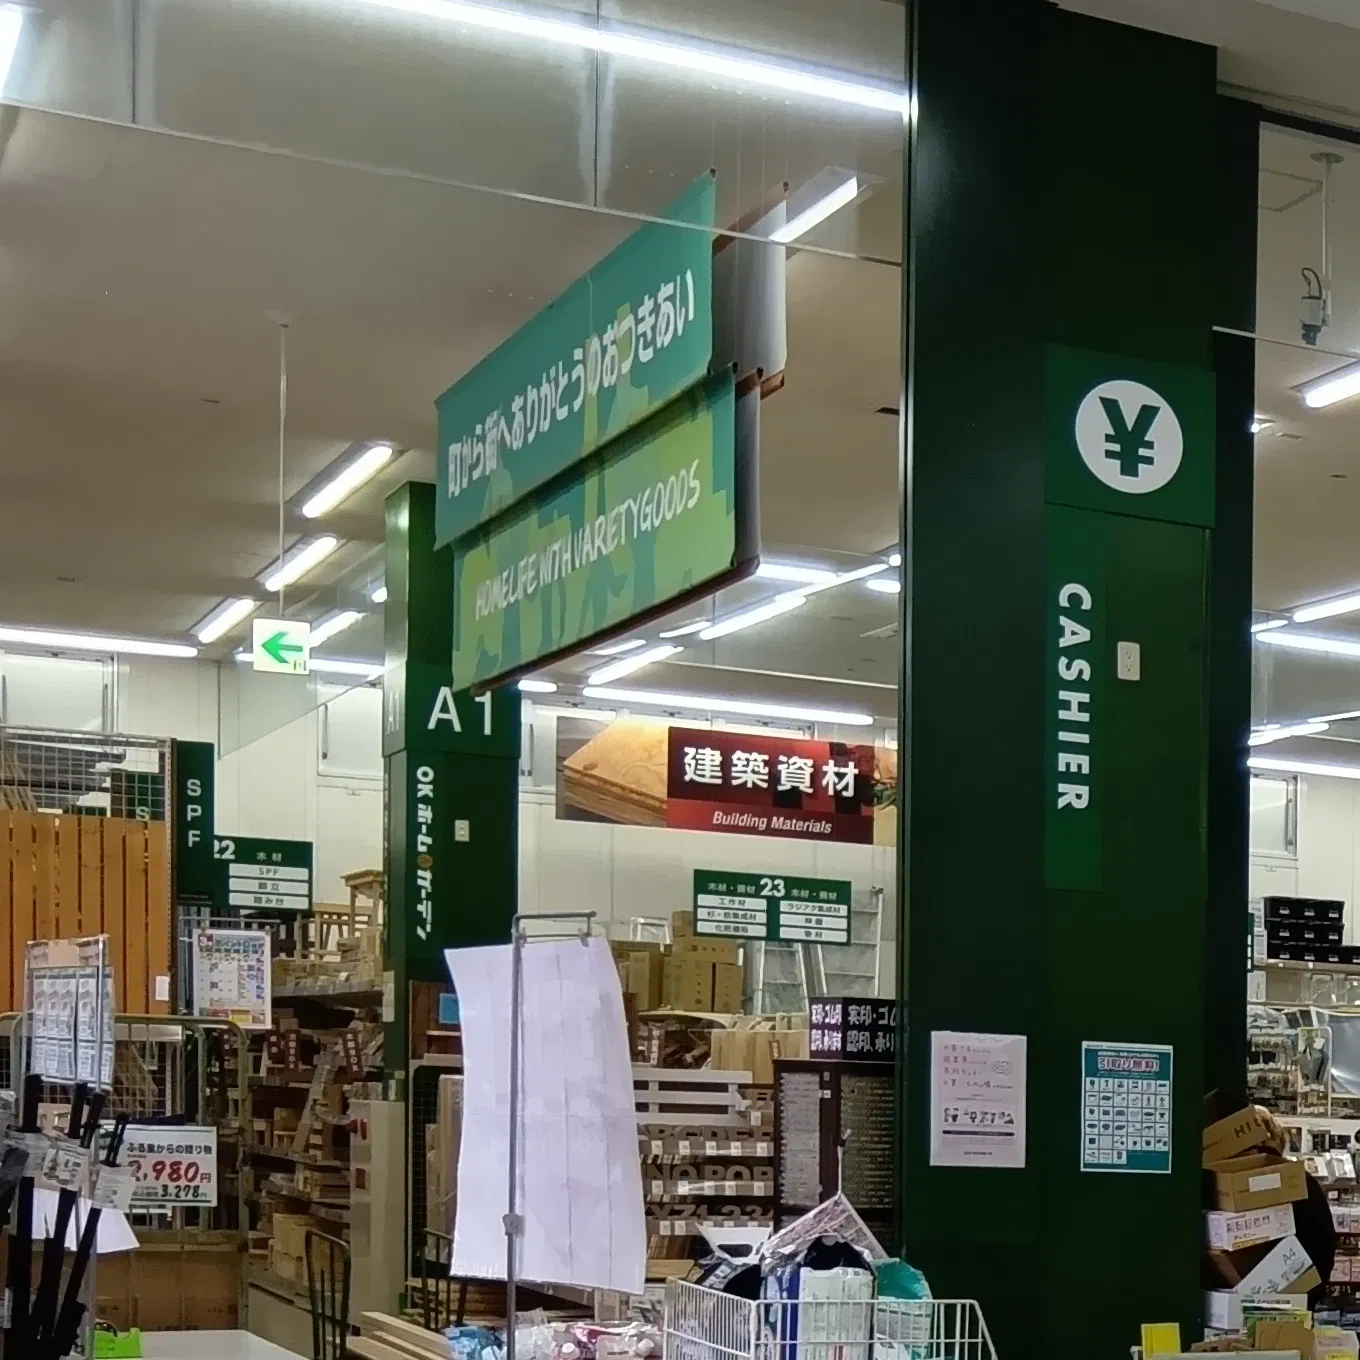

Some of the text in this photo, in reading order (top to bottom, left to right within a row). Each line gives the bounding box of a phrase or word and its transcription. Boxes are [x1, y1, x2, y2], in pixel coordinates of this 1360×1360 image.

[1057, 581, 1092, 811] CASHIER
[683, 745, 860, 799] 建築資材
[712, 810, 833, 836] Building Materials
[759, 878, 786, 898] 23
